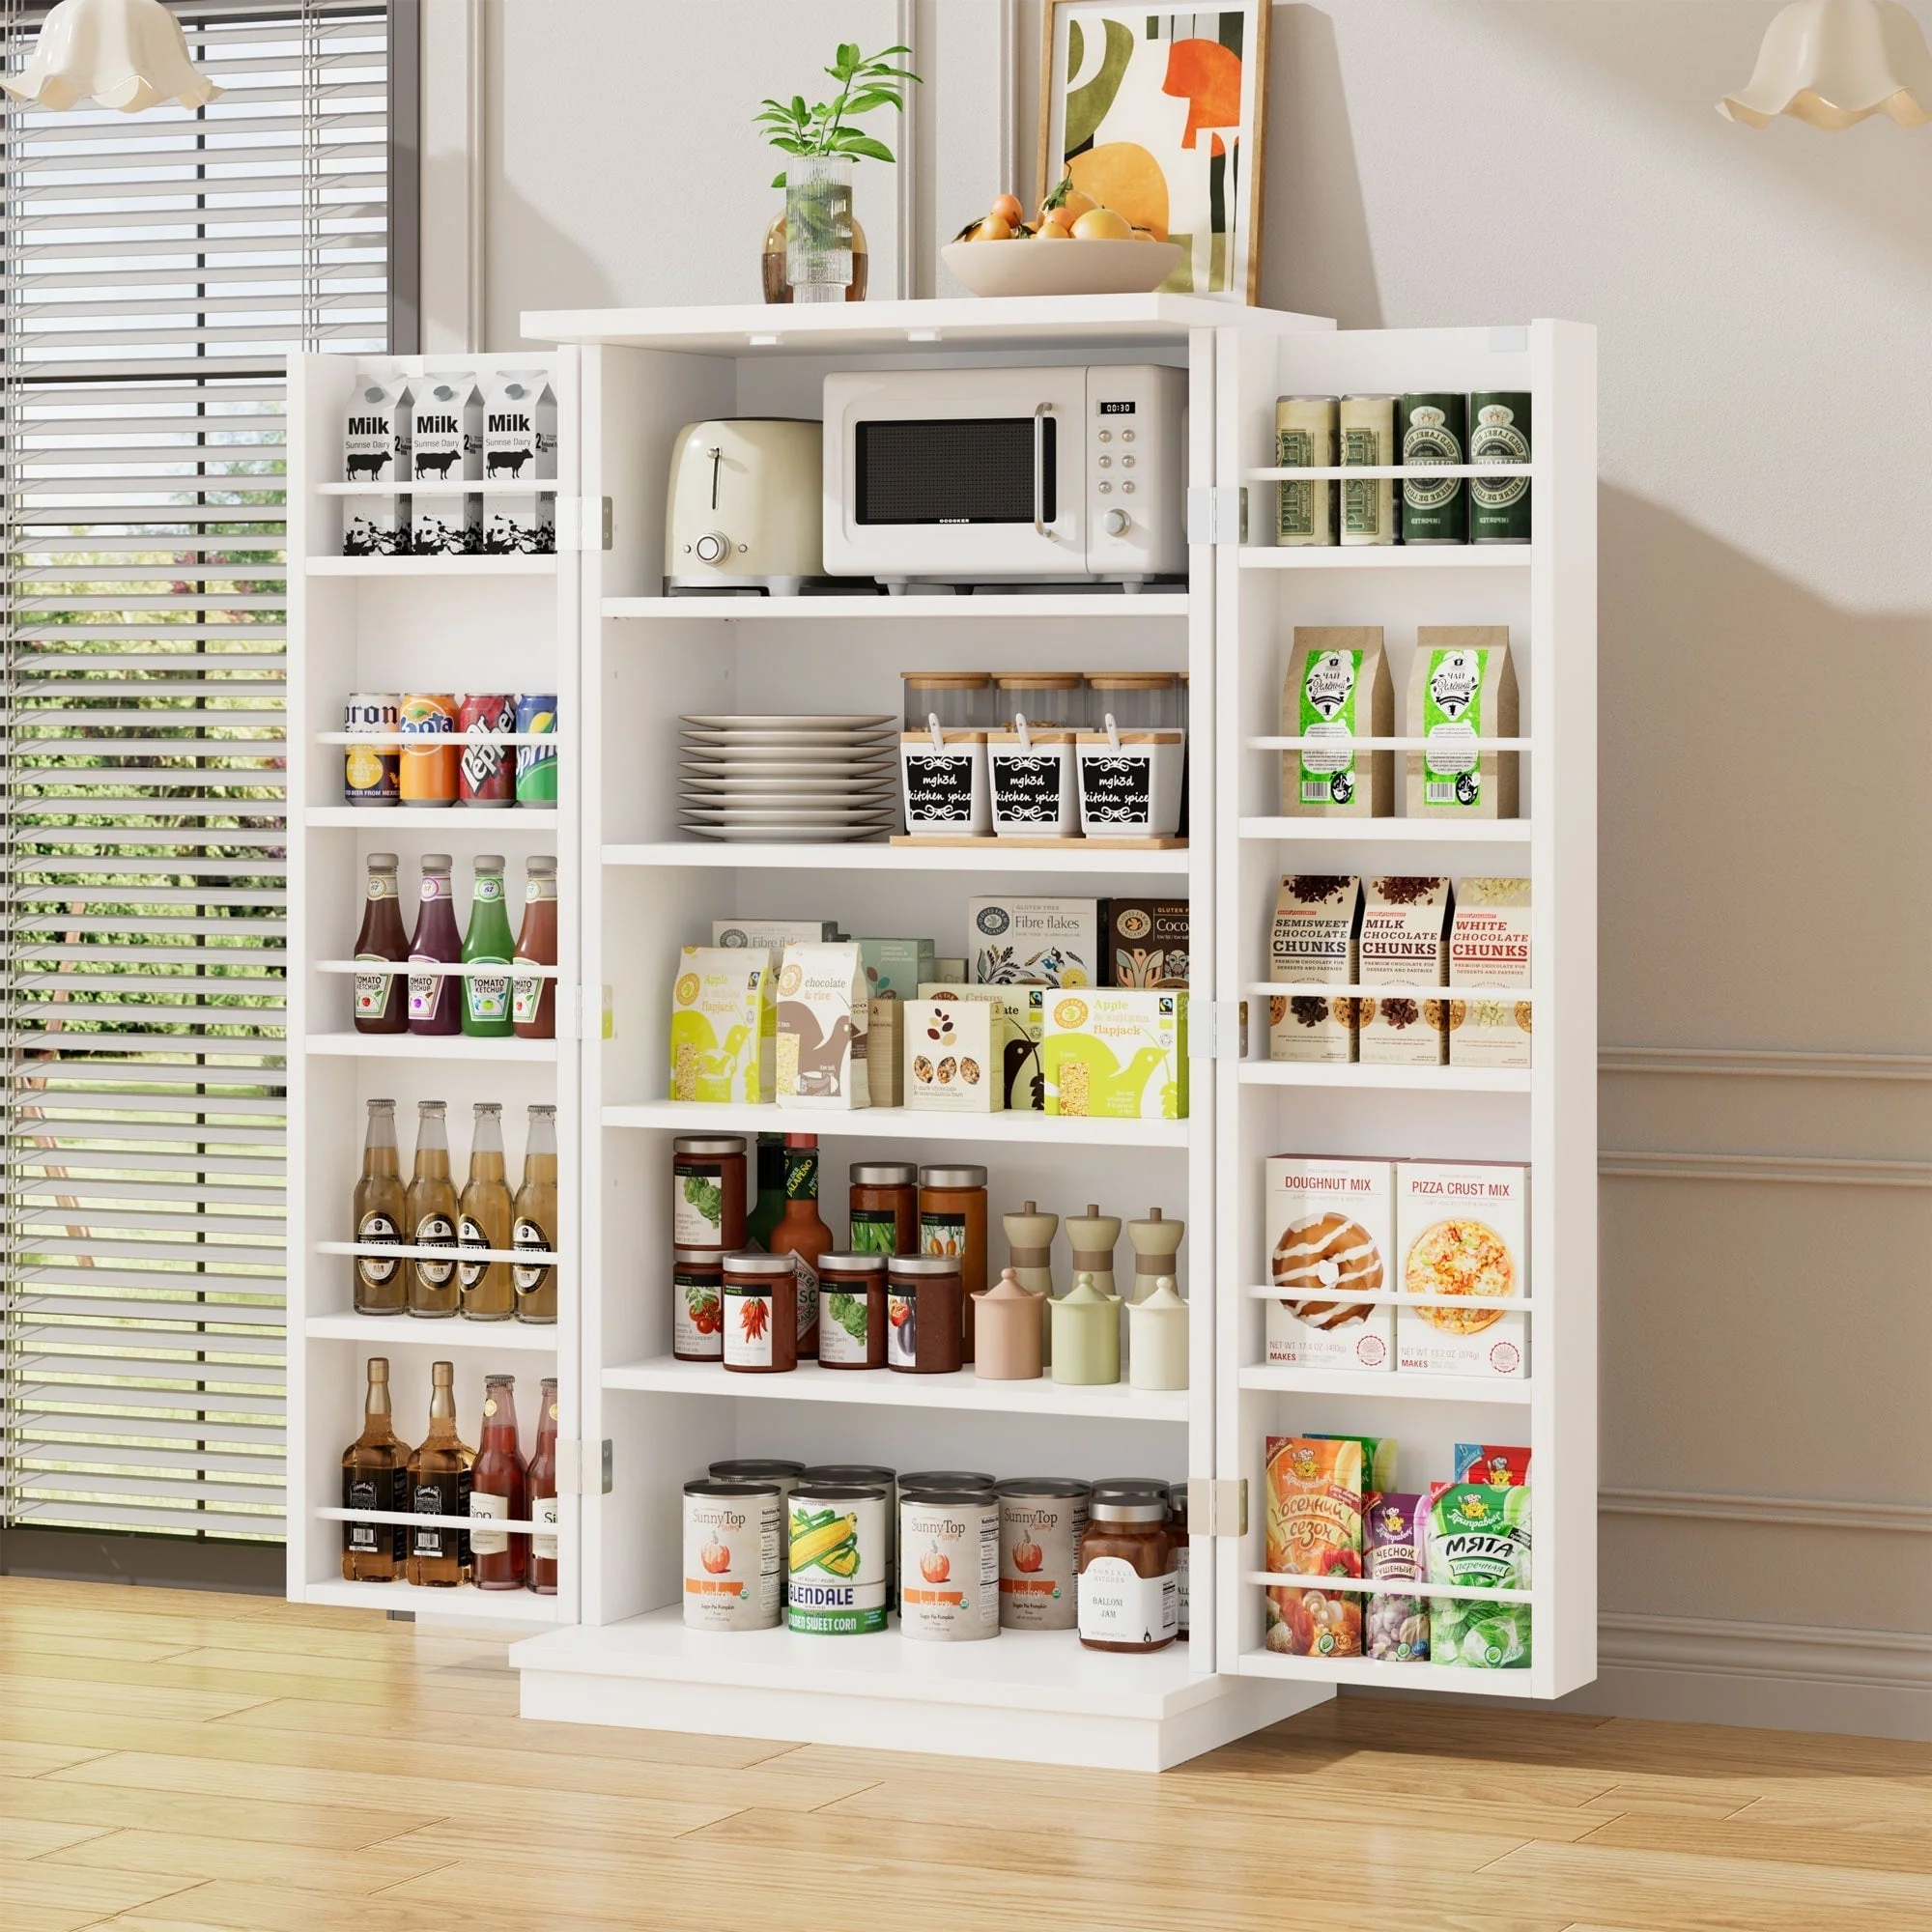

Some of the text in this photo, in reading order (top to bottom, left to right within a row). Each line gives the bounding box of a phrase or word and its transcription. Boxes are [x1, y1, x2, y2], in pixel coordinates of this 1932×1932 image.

[348, 417, 389, 436] Milk
[416, 415, 459, 434] Milk
[488, 413, 530, 432] Milk
[345, 440, 370, 449] Sunrise
[372, 440, 390, 450] Dairy
[413, 440, 460, 448] Sunrise Dairy
[513, 438, 531, 447] Dairy
[1282, 434, 1299, 530] PILSER
[1347, 434, 1365, 529] PILSER
[909, 789, 972, 804] kitchen spice
[996, 790, 1059, 805] kitchen spice
[1085, 791, 1150, 806] kitchen spice
[1015, 915, 1080, 929] Fibre flakes
[1275, 919, 1349, 928] SEMISWEET
[1365, 920, 1406, 929] MILK
[1456, 922, 1507, 931] WHITE
[1274, 929, 1348, 939] CHOCOLATE
[1363, 931, 1437, 941] CHOCOLATE
[1453, 933, 1528, 942] CHOCOLATE
[753, 936, 780, 949] Fibre
[1273, 940, 1346, 952] CHUNKS
[1362, 942, 1436, 955] CHUNKS
[1453, 945, 1528, 957] CHUNKS
[474, 979, 504, 987] TOMATO
[703, 974, 728, 985] Apple
[805, 977, 846, 989] chocolate
[813, 990, 831, 1001] rice
[1093, 999, 1128, 1011] Apple
[1094, 1013, 1150, 1023] & sultana
[1093, 1025, 1141, 1037] flapjack
[787, 1159, 812, 1198] JALAPEÑO
[1285, 1176, 1372, 1191] DOUGHNUT MIX
[1412, 1181, 1510, 1197] PIZZA CRUST MIX
[1269, 1341, 1283, 1350] NET
[1401, 1347, 1415, 1356] NET
[1269, 1352, 1296, 1361] MAKES
[1401, 1359, 1429, 1368] MAKES
[1281, 1497, 1344, 1520] осенний
[693, 1510, 746, 1526] SunnyTop
[1004, 1508, 1058, 1524] SunnyTop
[912, 1518, 966, 1535] SunnyTop
[1290, 1520, 1331, 1548] сезон
[1445, 1536, 1515, 1557] МЯТА
[1377, 1548, 1415, 1559] ЧЕСНОК
[1455, 1562, 1504, 1573] перечная
[1093, 1597, 1123, 1607] BALLONI
[1100, 1609, 1117, 1619] JAM
[807, 1617, 857, 1631] SWEET CORN
